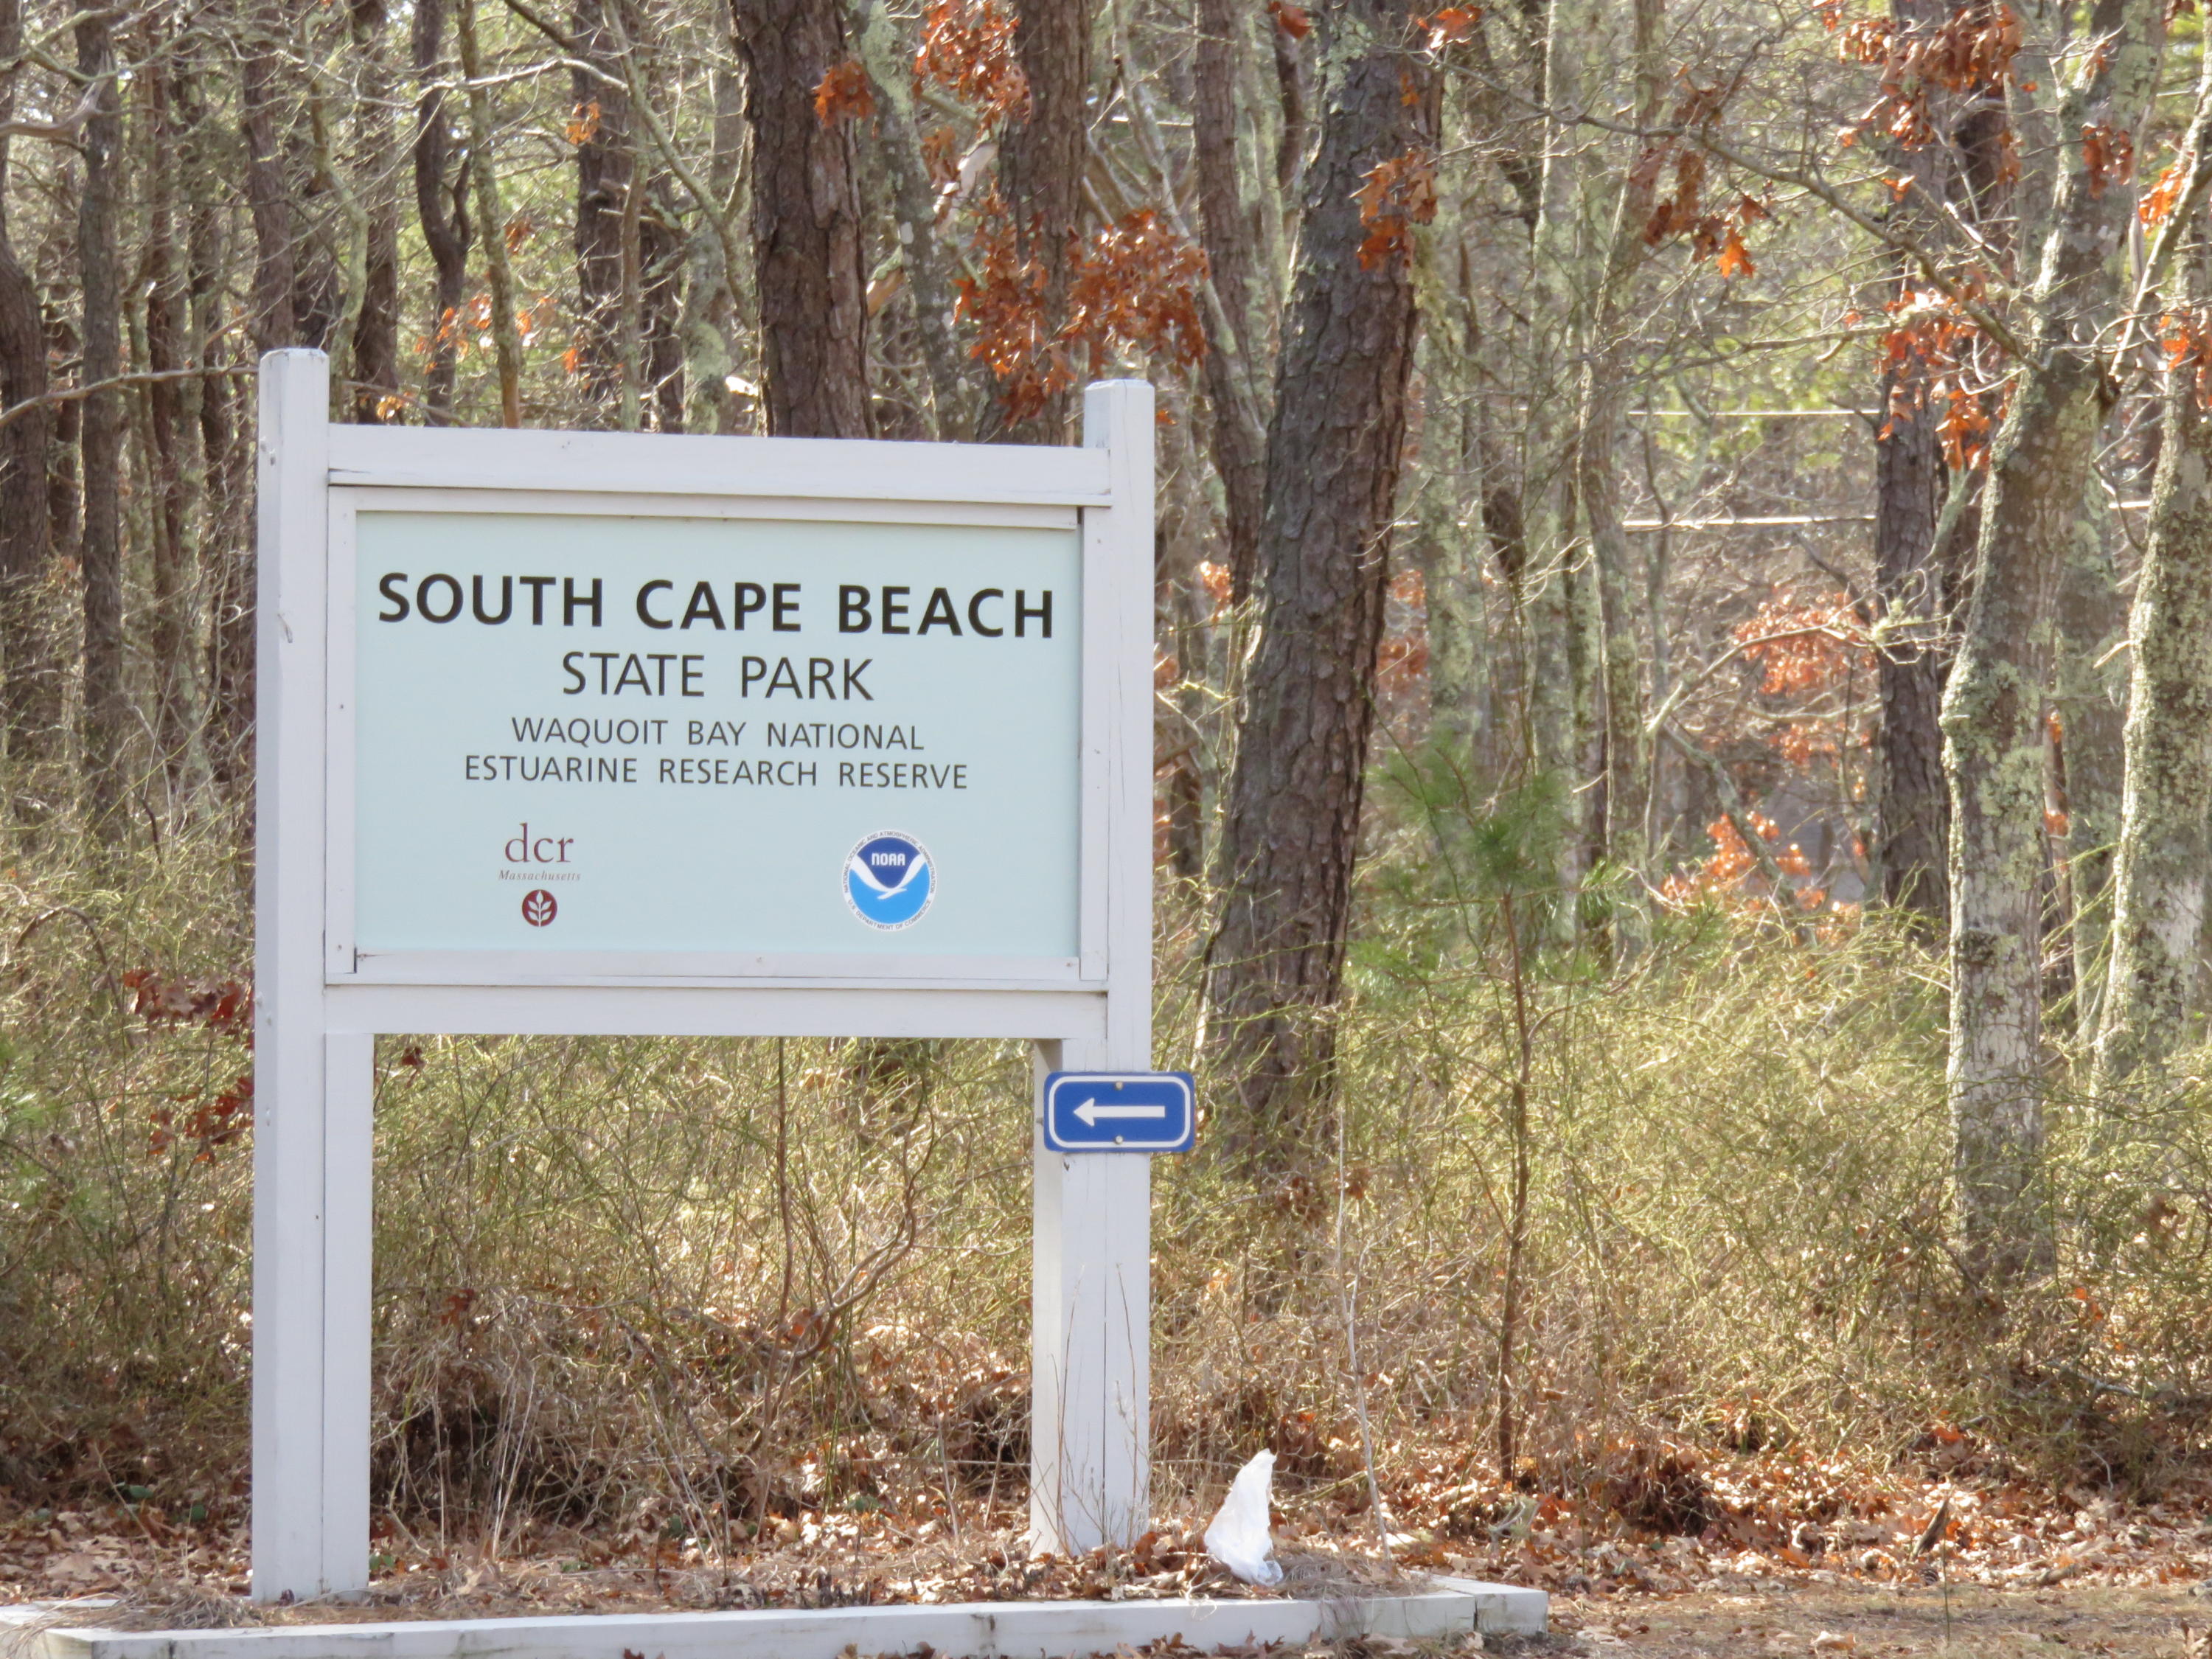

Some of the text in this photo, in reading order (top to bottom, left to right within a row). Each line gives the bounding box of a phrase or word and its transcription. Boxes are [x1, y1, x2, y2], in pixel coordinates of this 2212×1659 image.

[378, 572, 1053, 639] SOUTH CAPE BEACH
[563, 651, 874, 701] STATE PARK
[512, 717, 925, 751] WAQUOIT BAY NATIONAL
[465, 755, 967, 789] ESTUARINE RESEARCH RESERVE
[504, 822, 574, 863] dcr
[871, 852, 905, 866] NOAA
[498, 869, 581, 881] Massachusetts
